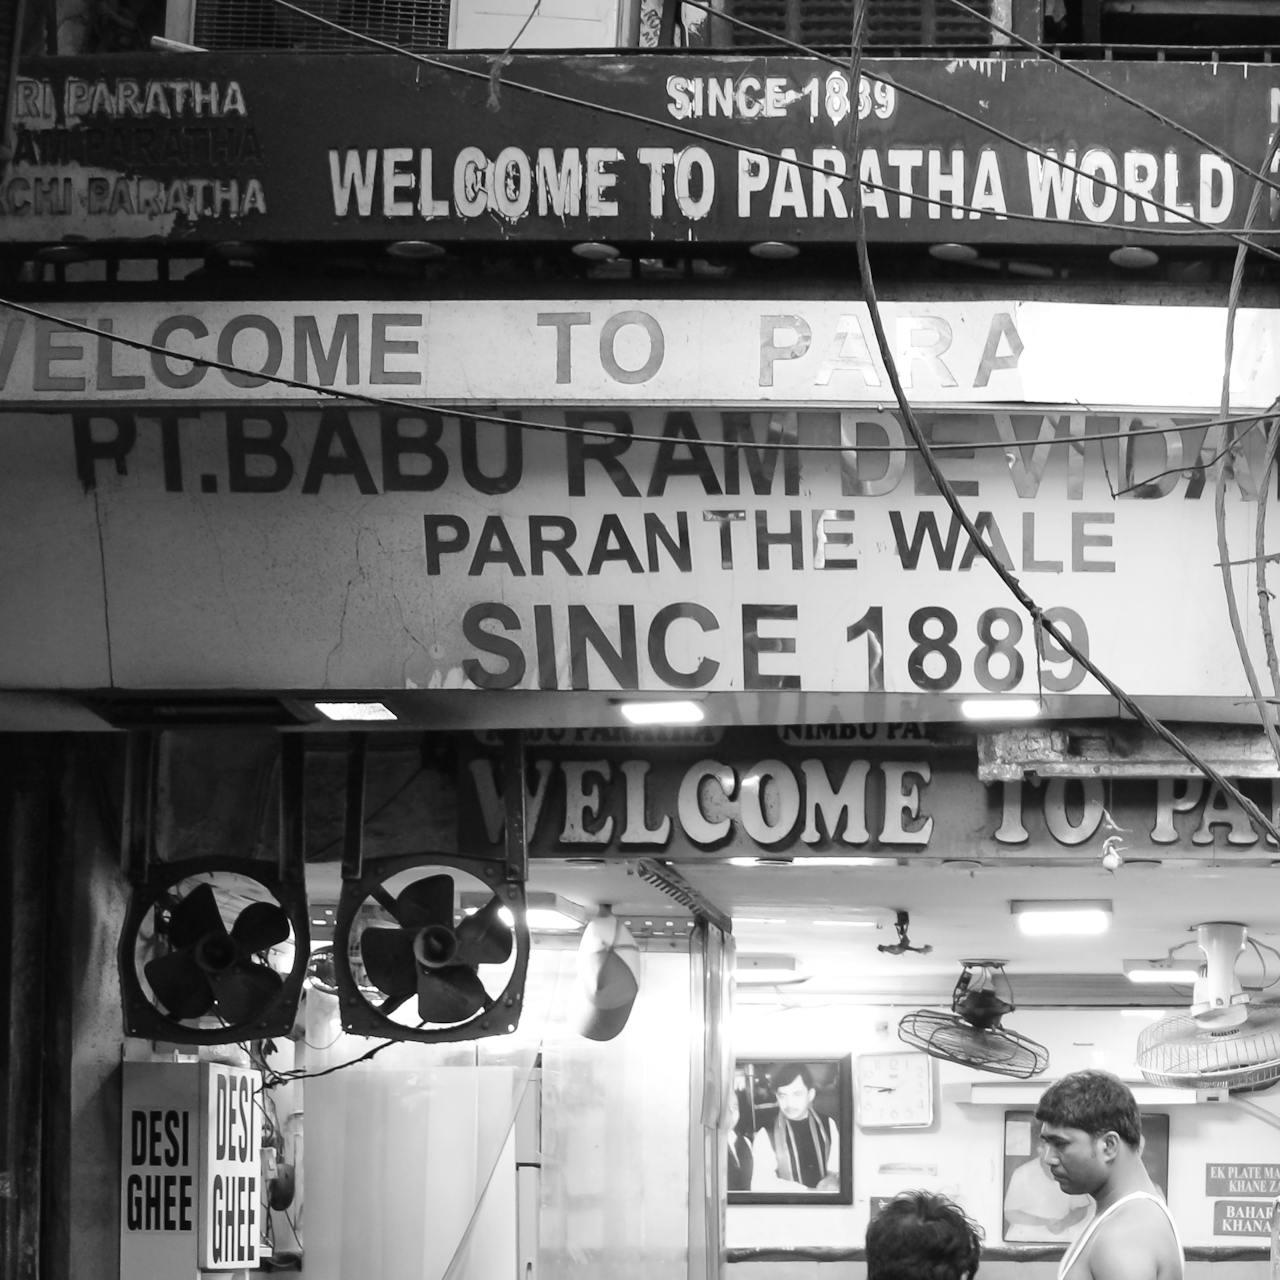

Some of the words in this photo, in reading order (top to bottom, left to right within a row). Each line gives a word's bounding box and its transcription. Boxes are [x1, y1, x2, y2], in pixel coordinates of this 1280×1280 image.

[66, 79, 247, 117] PARATHA
[667, 75, 787, 120] SINCE
[88, 176, 267, 219] PARATHA
[328, 145, 625, 220] WELCOME
[637, 146, 716, 220] TO
[737, 147, 1007, 222] PARATHA
[1026, 148, 1235, 225] WORLD
[537, 310, 665, 385] TO
[70, 410, 524, 495] PT.BABU
[566, 410, 800, 497] RAM
[423, 509, 858, 577] PARANTHE
[888, 511, 1116, 574] WALE
[461, 602, 801, 692] SINCE
[846, 605, 1090, 693] 1889
[468, 758, 935, 846] WELCOME
[131, 1110, 189, 1168] DESI
[216, 1073, 254, 1164] DESI
[127, 1174, 192, 1232] GHEE
[1210, 1166, 1226, 1179] EK
[1228, 1166, 1262, 1180] PLATE
[1229, 1180, 1267, 1193] KHANE
[213, 1174, 255, 1265] GHEE
[1222, 1219, 1271, 1232] KHANA
